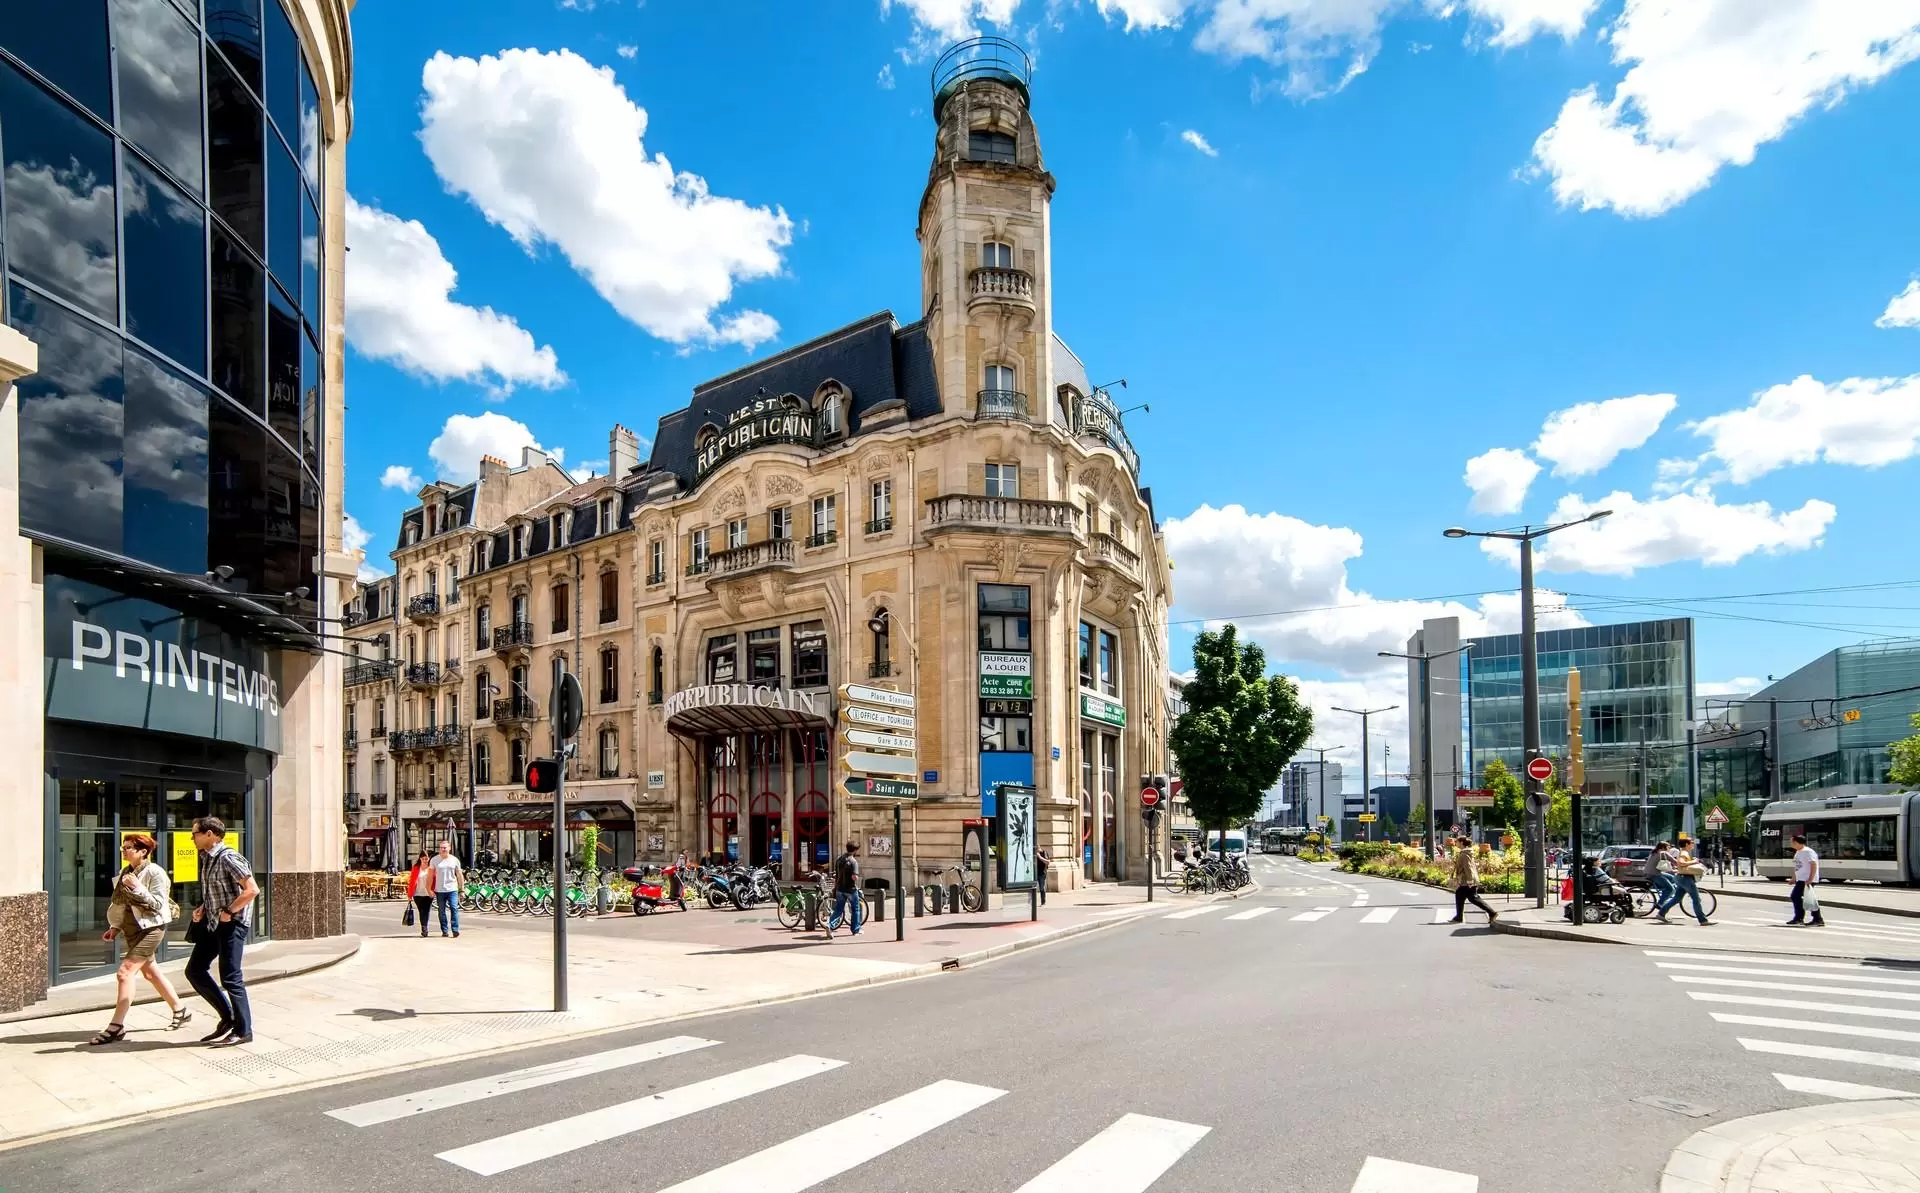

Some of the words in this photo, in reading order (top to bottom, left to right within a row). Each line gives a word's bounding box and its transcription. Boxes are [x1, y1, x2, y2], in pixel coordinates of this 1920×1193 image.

[729, 398, 777, 425] L'EST
[72, 620, 278, 716] PRINTEMPS
[676, 683, 815, 714] RÉPUBLICAIN
[871, 692, 885, 701] Place
[889, 695, 912, 705] Stanislas
[861, 710, 878, 720] OFFICE
[887, 716, 912, 726] TOURISME
[876, 783, 895, 793] Saint
[900, 786, 915, 795] Jean
[1761, 828, 1780, 836] stan
